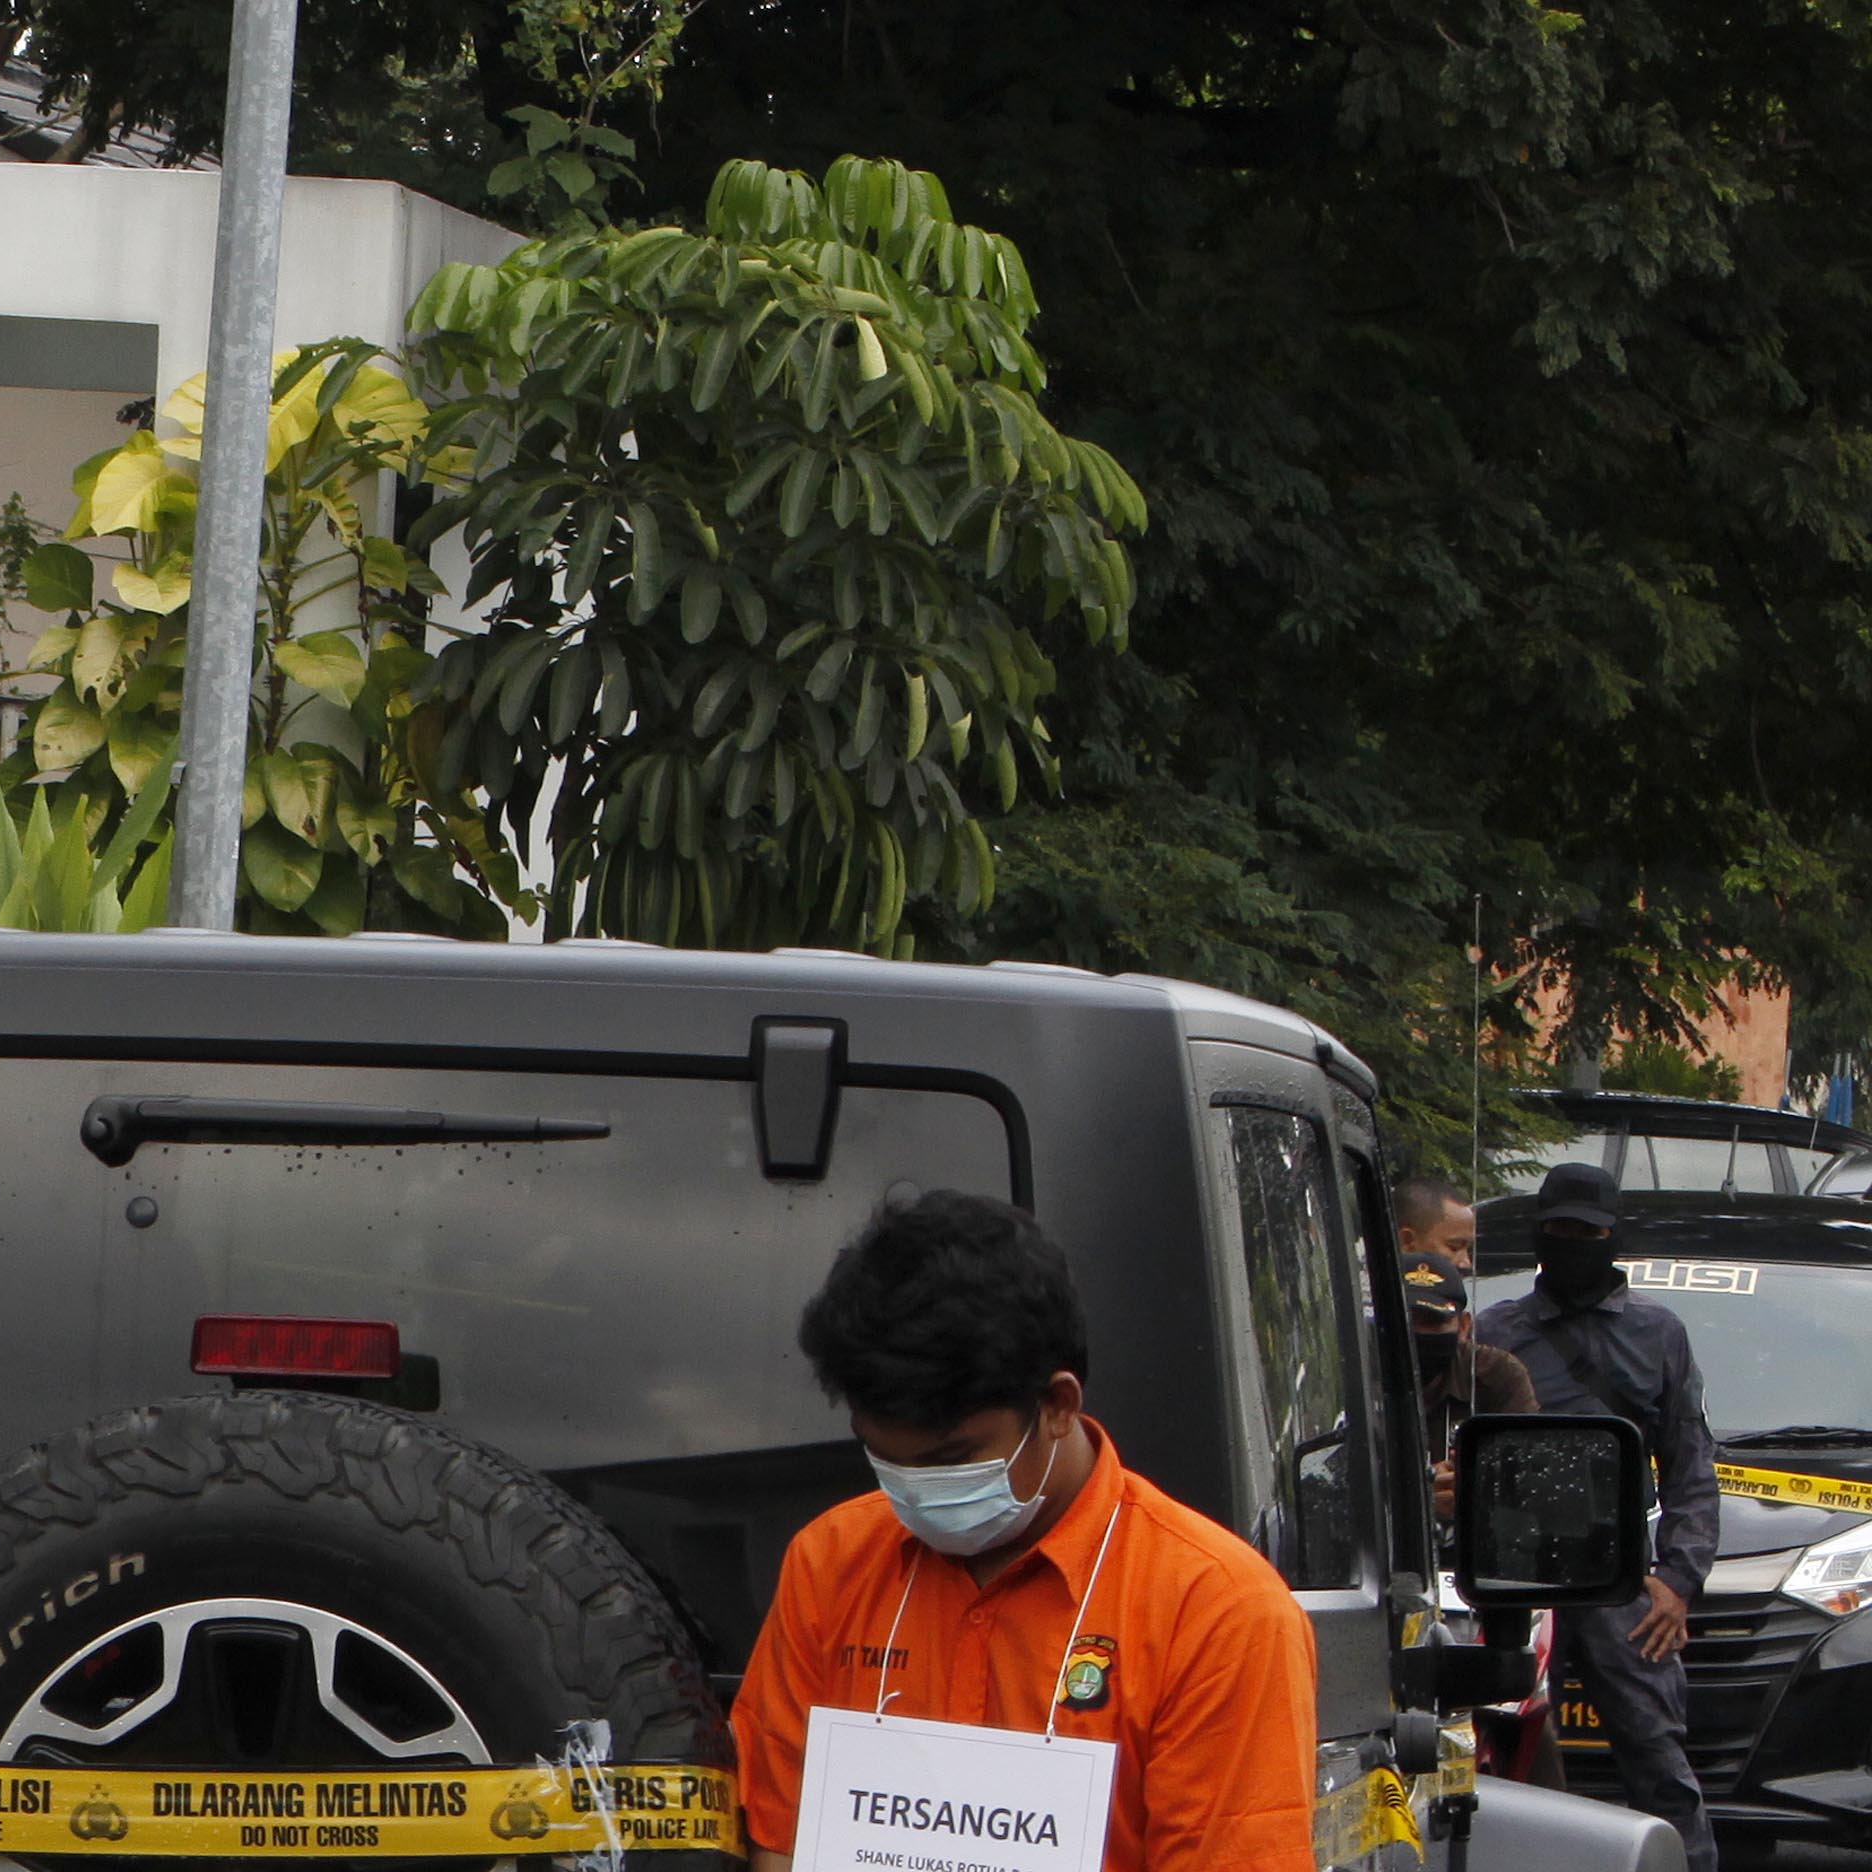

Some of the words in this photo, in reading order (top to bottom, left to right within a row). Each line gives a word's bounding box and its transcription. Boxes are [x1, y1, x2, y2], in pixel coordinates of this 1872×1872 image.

[1612, 1261, 1759, 1295] LISI
[1818, 1491, 1860, 1509] POLISI
[152, 1781, 305, 1818] DILARANG
[315, 1781, 468, 1818] MELINTAS
[240, 1825, 268, 1848] DO
[272, 1825, 311, 1848] NOT
[316, 1825, 379, 1848] CROSS
[620, 1818, 686, 1840] POLICE
[848, 1789, 1059, 1848] TERSANGKA
[855, 1849, 904, 1868] SHANE
